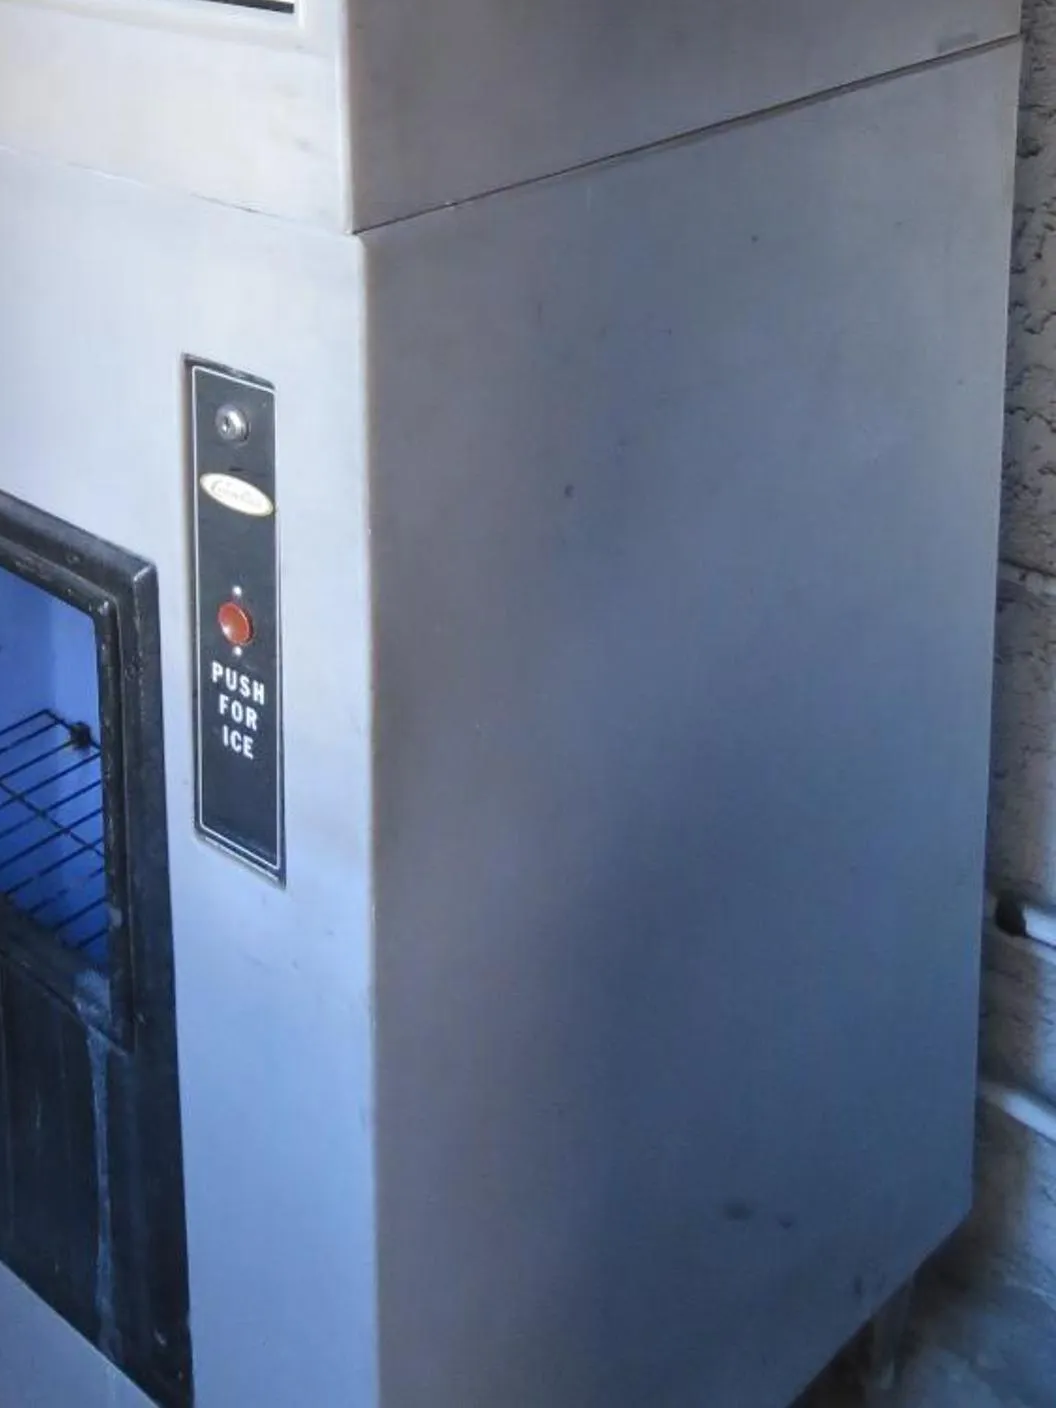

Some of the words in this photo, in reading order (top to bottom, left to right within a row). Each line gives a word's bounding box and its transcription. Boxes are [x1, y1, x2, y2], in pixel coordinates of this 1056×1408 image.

[211, 660, 264, 705] PUSH
[219, 693, 257, 731] FOR
[223, 724, 254, 760] ICE
